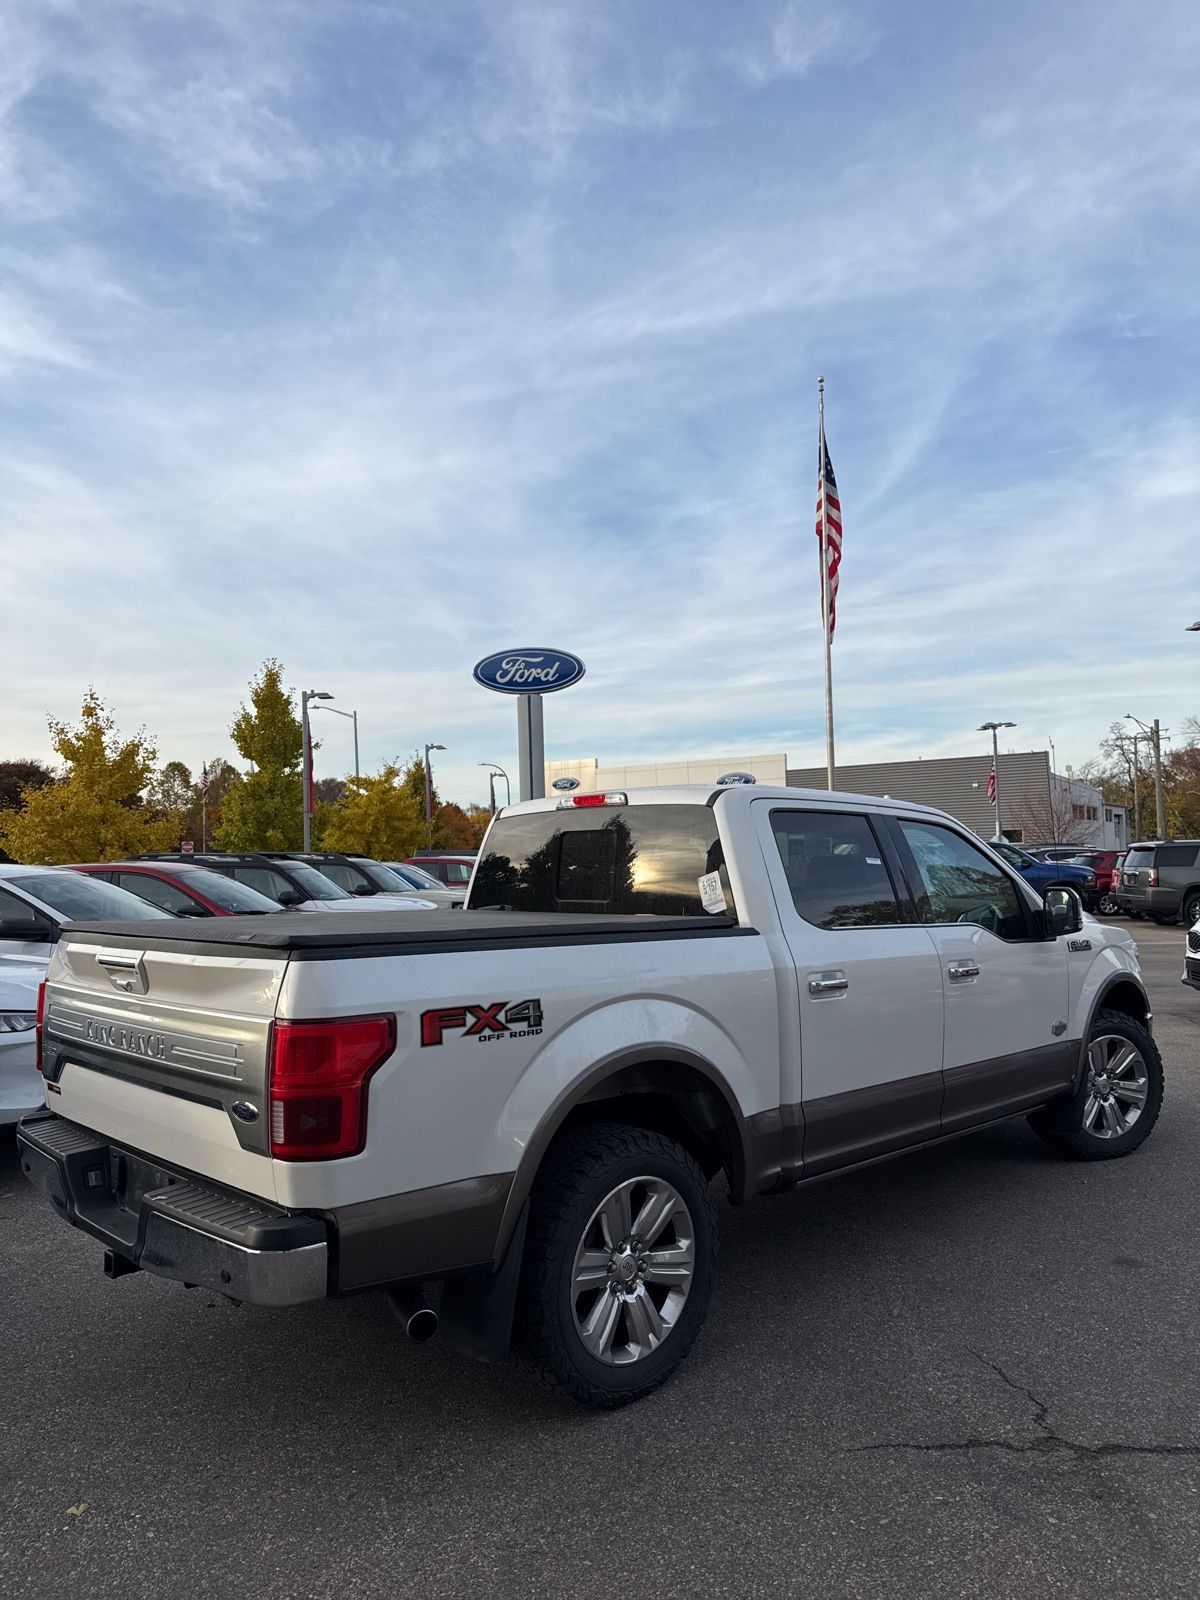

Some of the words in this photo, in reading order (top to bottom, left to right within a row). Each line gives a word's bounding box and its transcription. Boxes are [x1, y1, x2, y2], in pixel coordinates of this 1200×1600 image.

[495, 656, 561, 683] Ford
[87, 1018, 115, 1046] KING
[120, 1028, 166, 1059] RANCH
[420, 998, 543, 1048] FX4
[478, 1033, 504, 1042] OFF
[509, 1028, 543, 1038] ROAD
